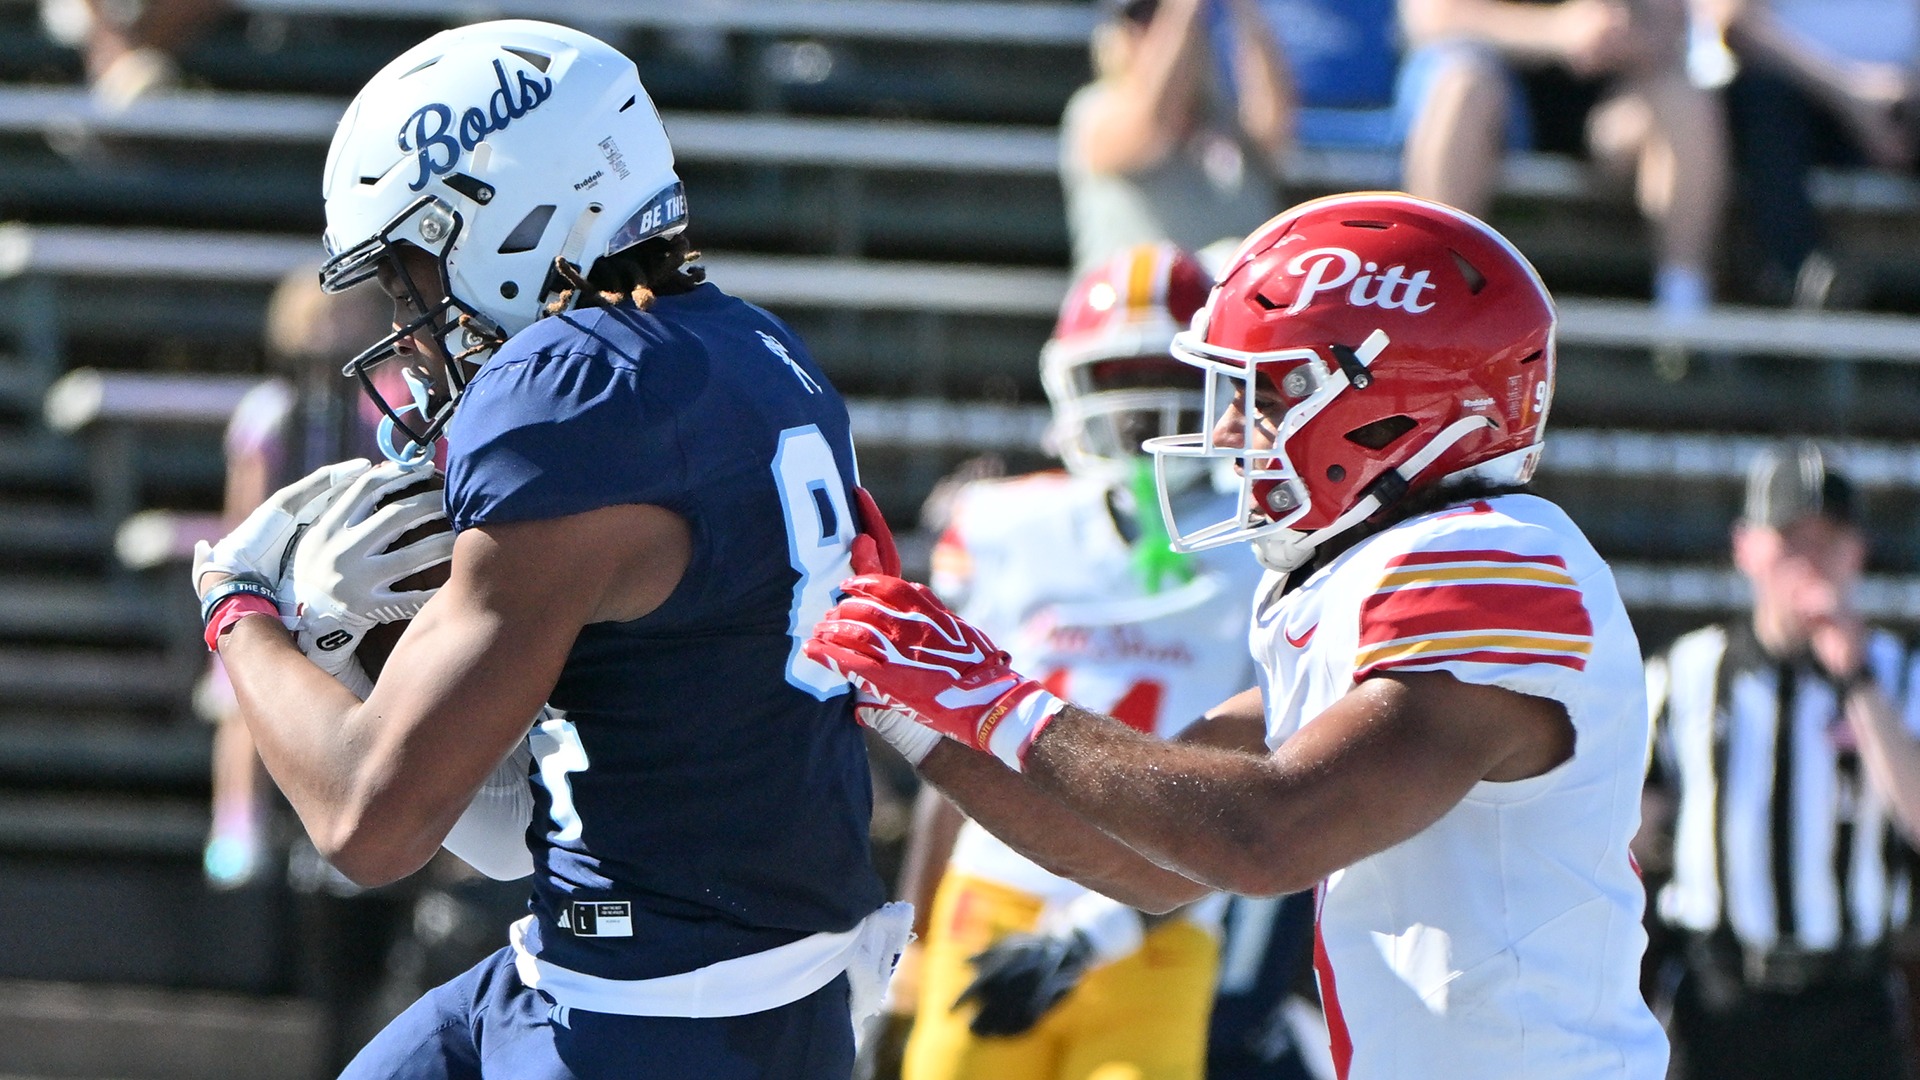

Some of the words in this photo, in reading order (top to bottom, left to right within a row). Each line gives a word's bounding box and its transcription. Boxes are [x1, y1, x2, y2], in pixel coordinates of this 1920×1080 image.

[399, 58, 552, 192] Bods
[640, 205, 661, 235] BE
[666, 195, 685, 220] THE
[1287, 247, 1436, 315] Pitt
[1533, 380, 1546, 413] 9
[239, 583, 259, 594] THE
[989, 705, 1008, 725] DNA
[580, 916, 587, 930] L
